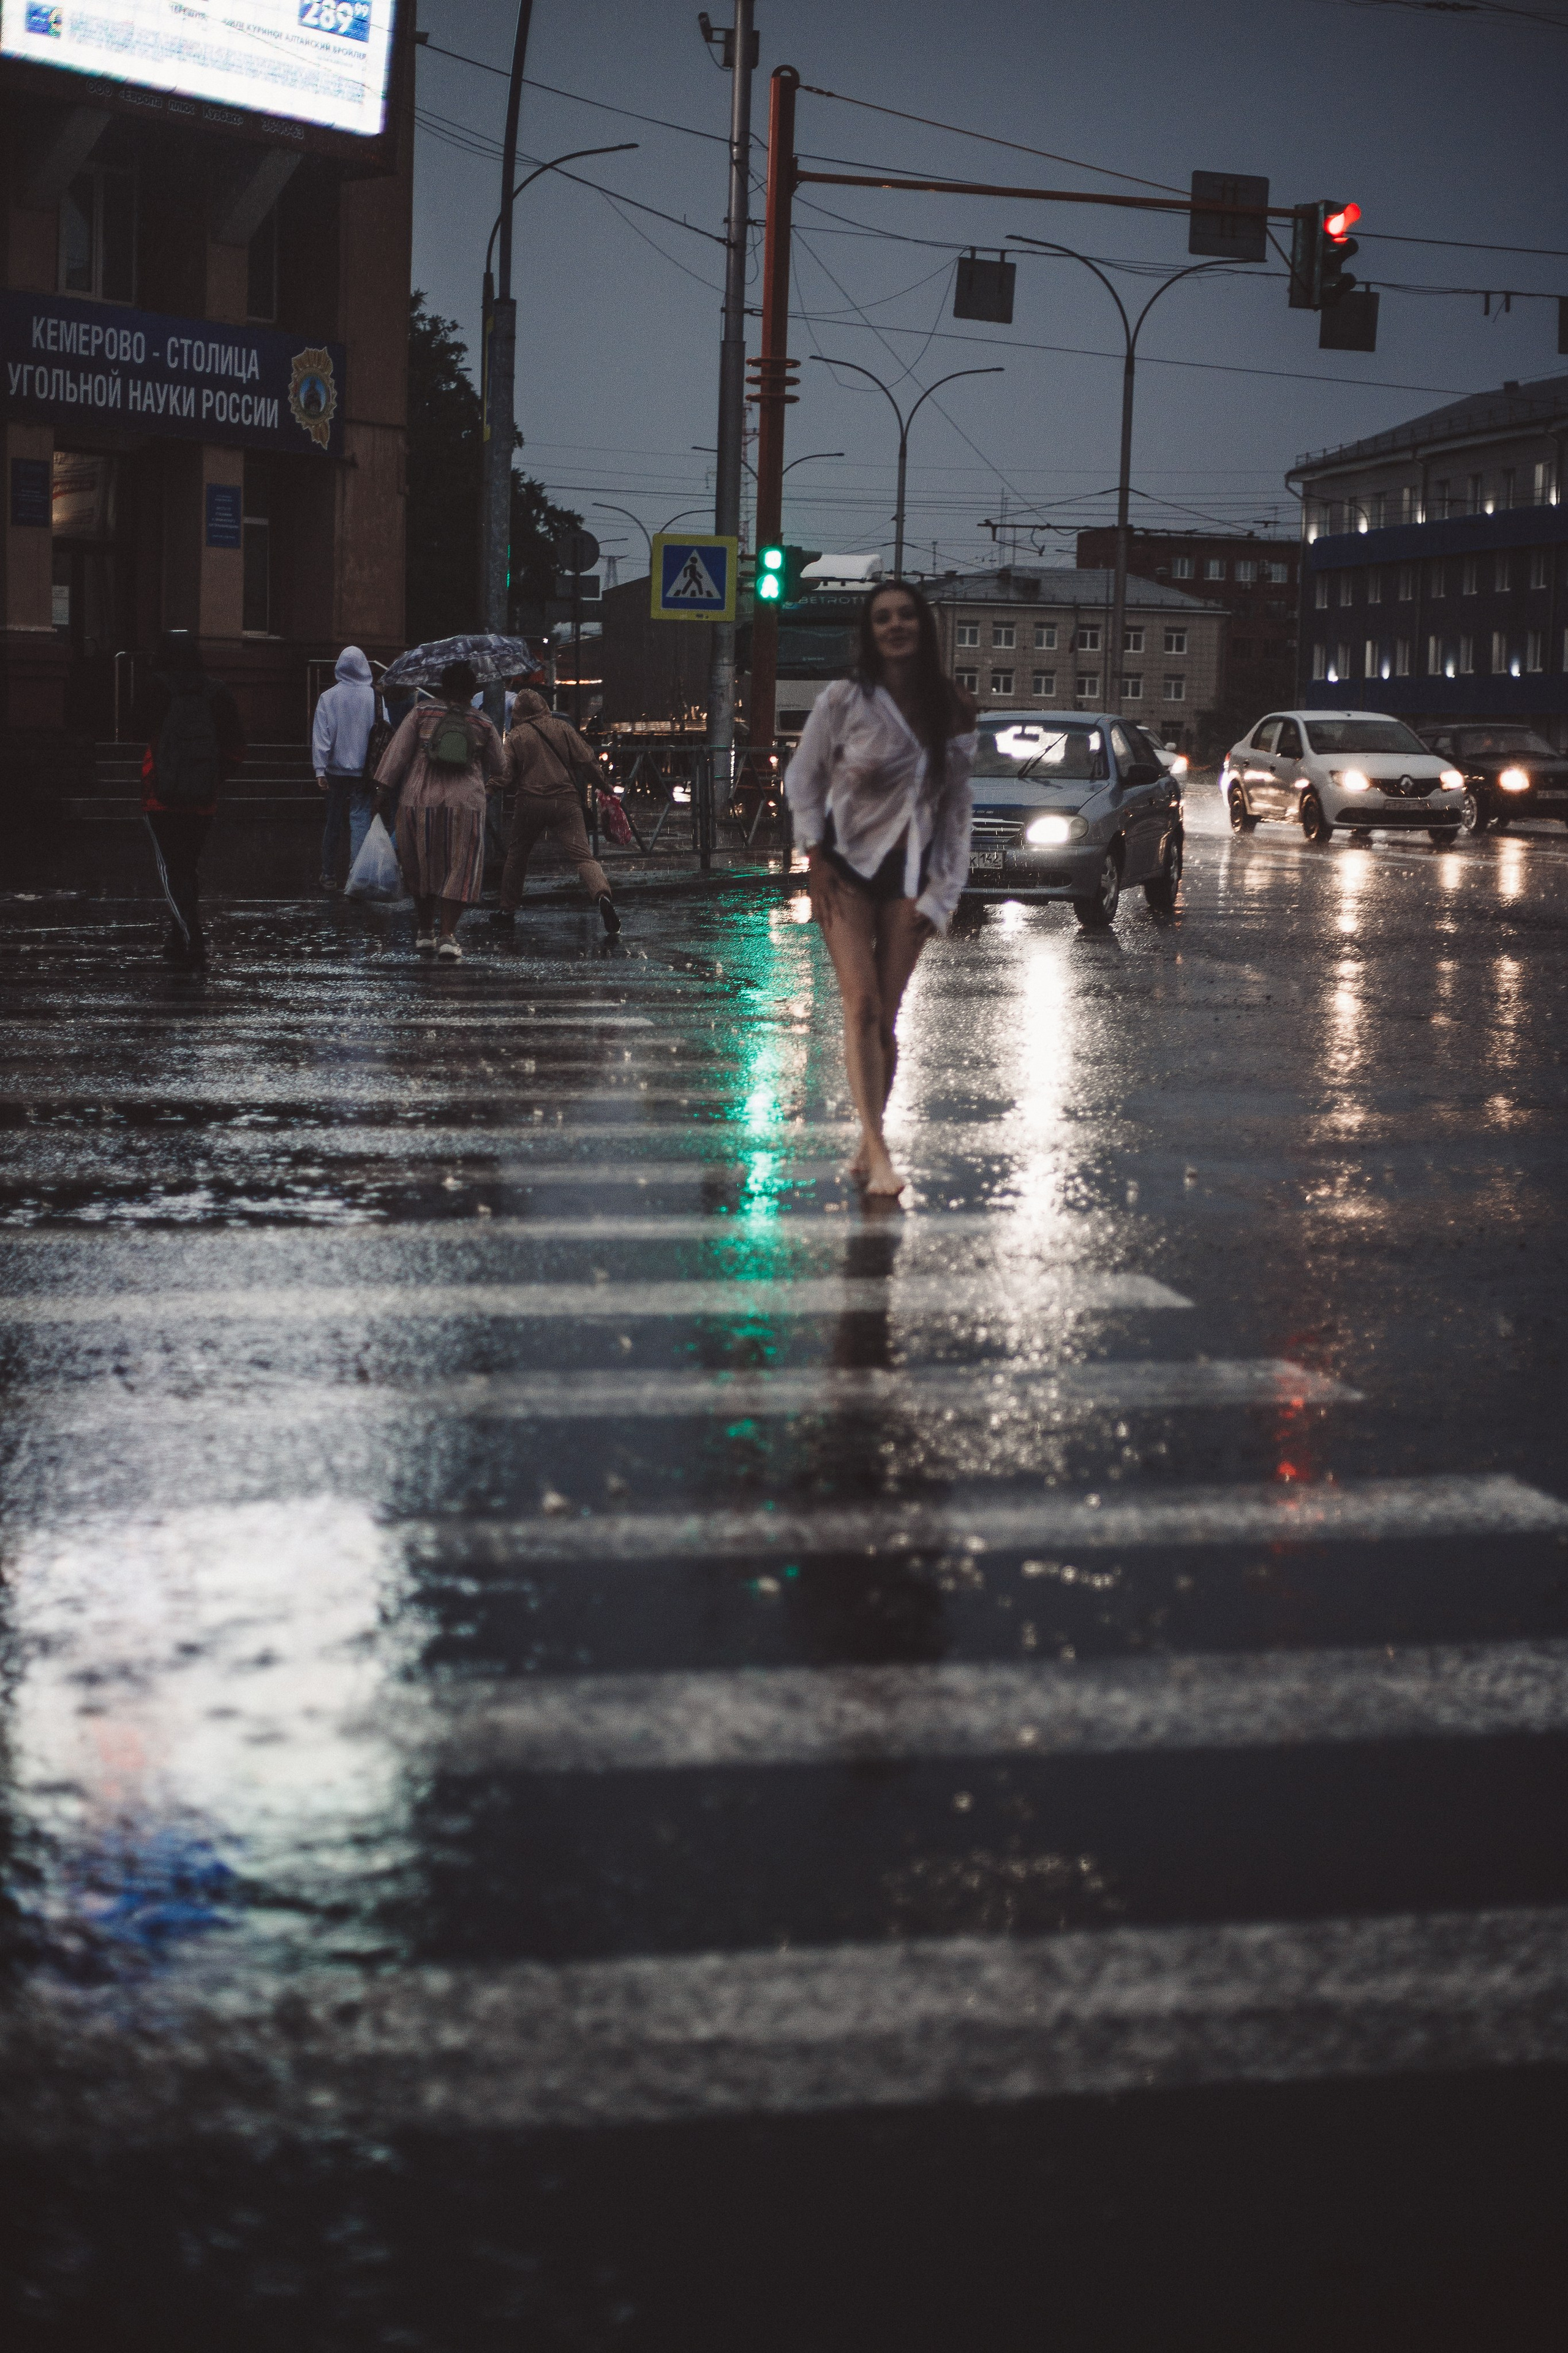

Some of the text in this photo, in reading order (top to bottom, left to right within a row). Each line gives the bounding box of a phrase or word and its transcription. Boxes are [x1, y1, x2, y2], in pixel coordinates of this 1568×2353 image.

[302, 0, 353, 33] 289
[32, 316, 145, 364] КЕМЕРОВО
[167, 336, 260, 384] СТОЛИЦА
[7, 361, 279, 429] УГОЛЬНОЙ НАУКИ РОССИИ
